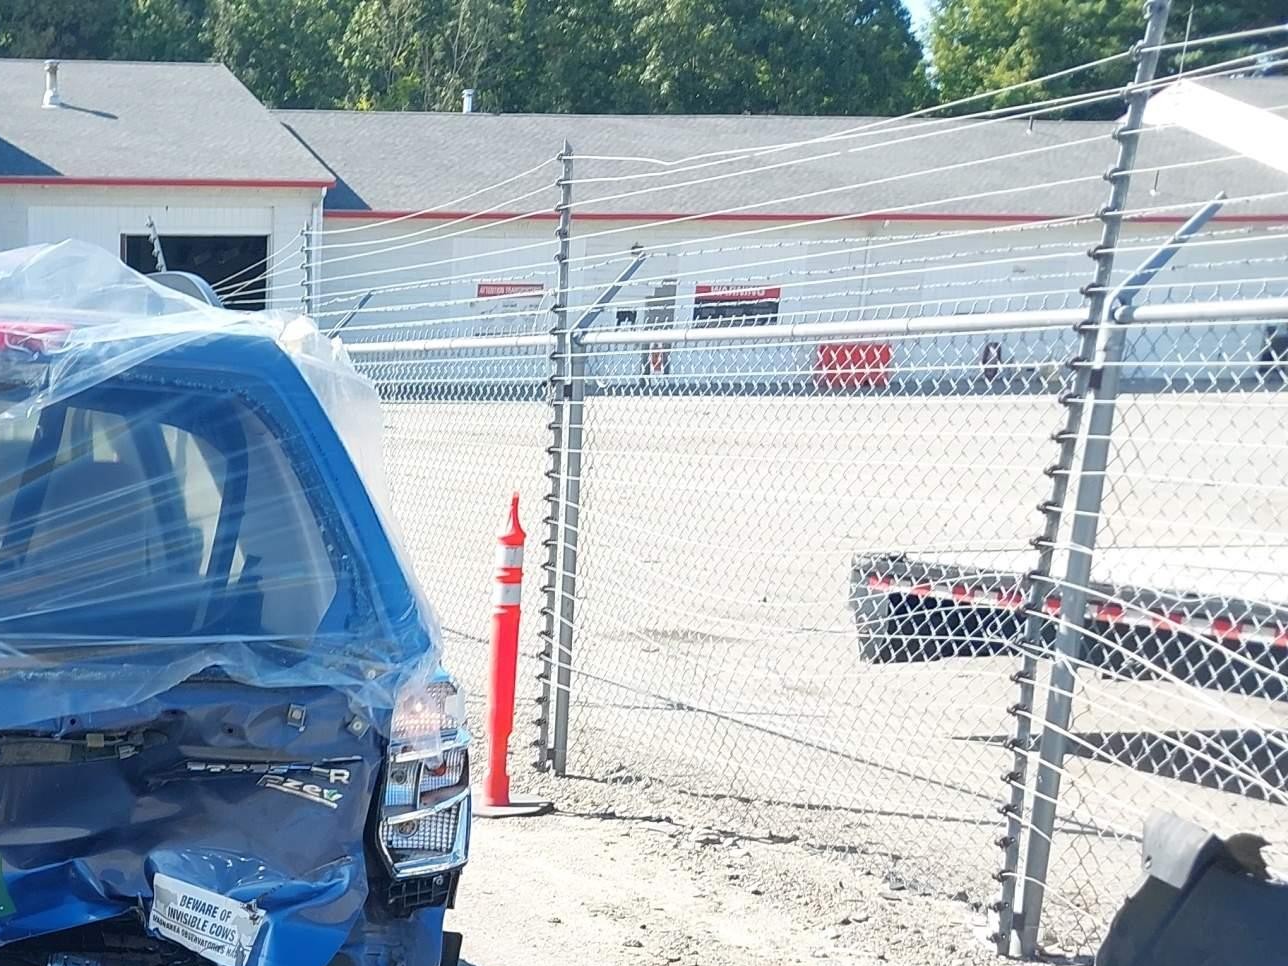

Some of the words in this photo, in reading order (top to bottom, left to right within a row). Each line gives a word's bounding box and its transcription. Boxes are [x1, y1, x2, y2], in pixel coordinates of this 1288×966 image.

[167, 906, 209, 932] INVISIBLE
[209, 922, 236, 942] COWS
[179, 895, 219, 918] BEWARE
[219, 909, 232, 922] OF
